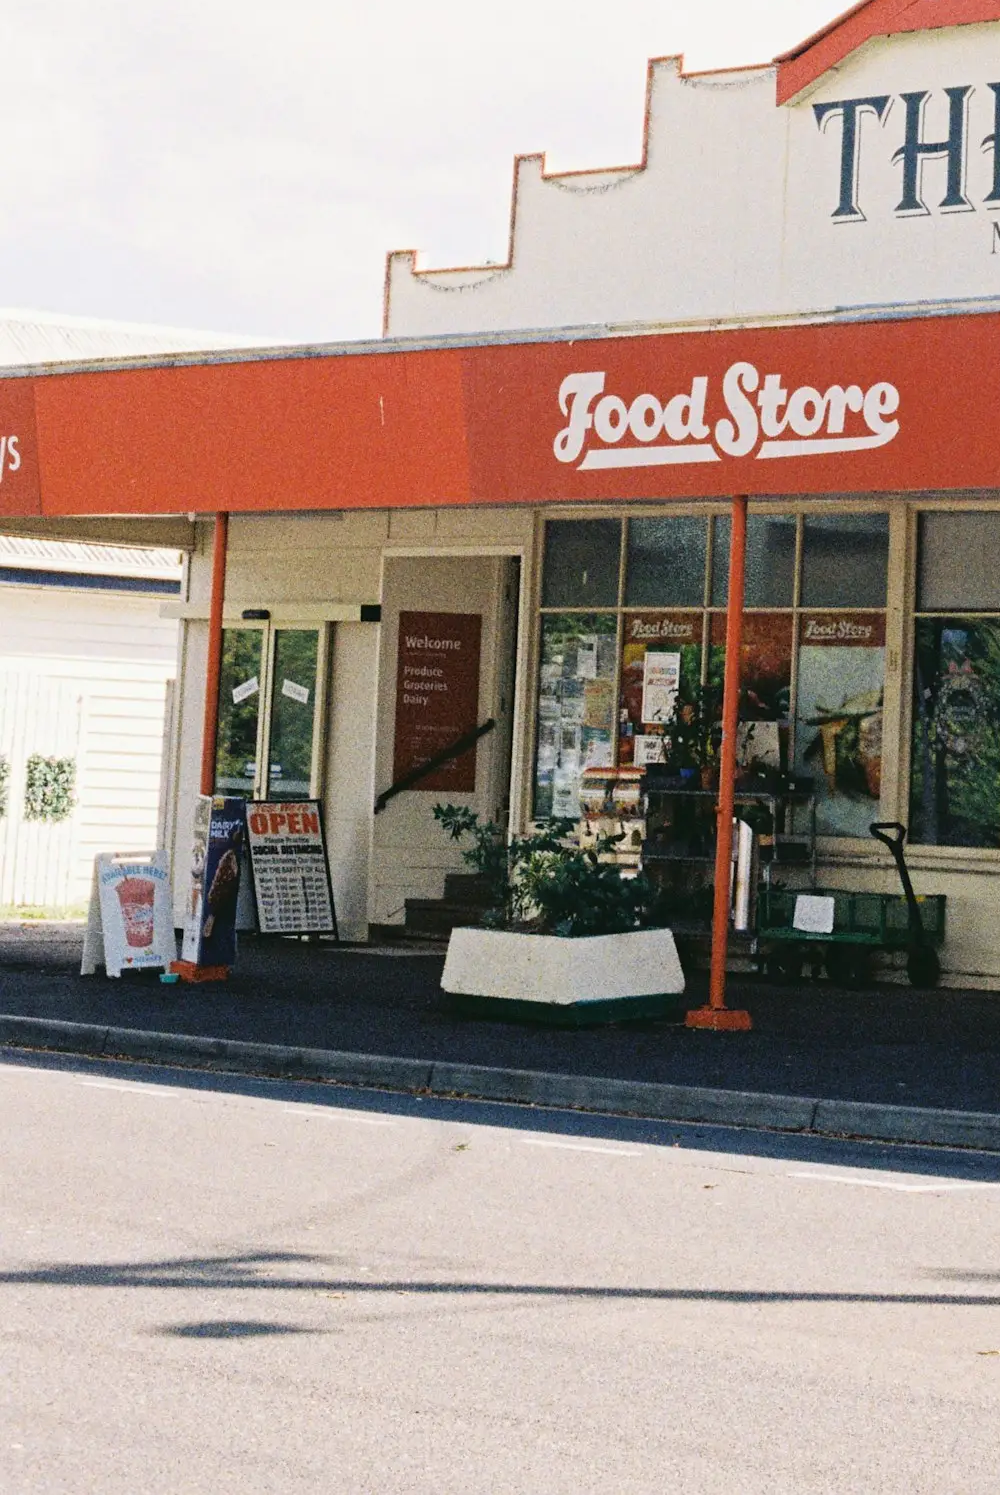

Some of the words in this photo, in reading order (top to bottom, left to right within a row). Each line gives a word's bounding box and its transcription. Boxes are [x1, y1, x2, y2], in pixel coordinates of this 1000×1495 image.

[553, 370, 710, 464] Food
[715, 361, 900, 459] Store
[805, 620, 837, 638] Food
[837, 620, 872, 639] Store
[405, 635, 461, 650] Welcome
[404, 665, 443, 677] Produce
[404, 679, 448, 691] Groceries
[403, 693, 429, 706] Dairy
[210, 820, 235, 831] DAIRY
[249, 812, 319, 834] OPEN
[210, 830, 230, 839] MILK
[252, 845, 279, 855] SOCIAL
